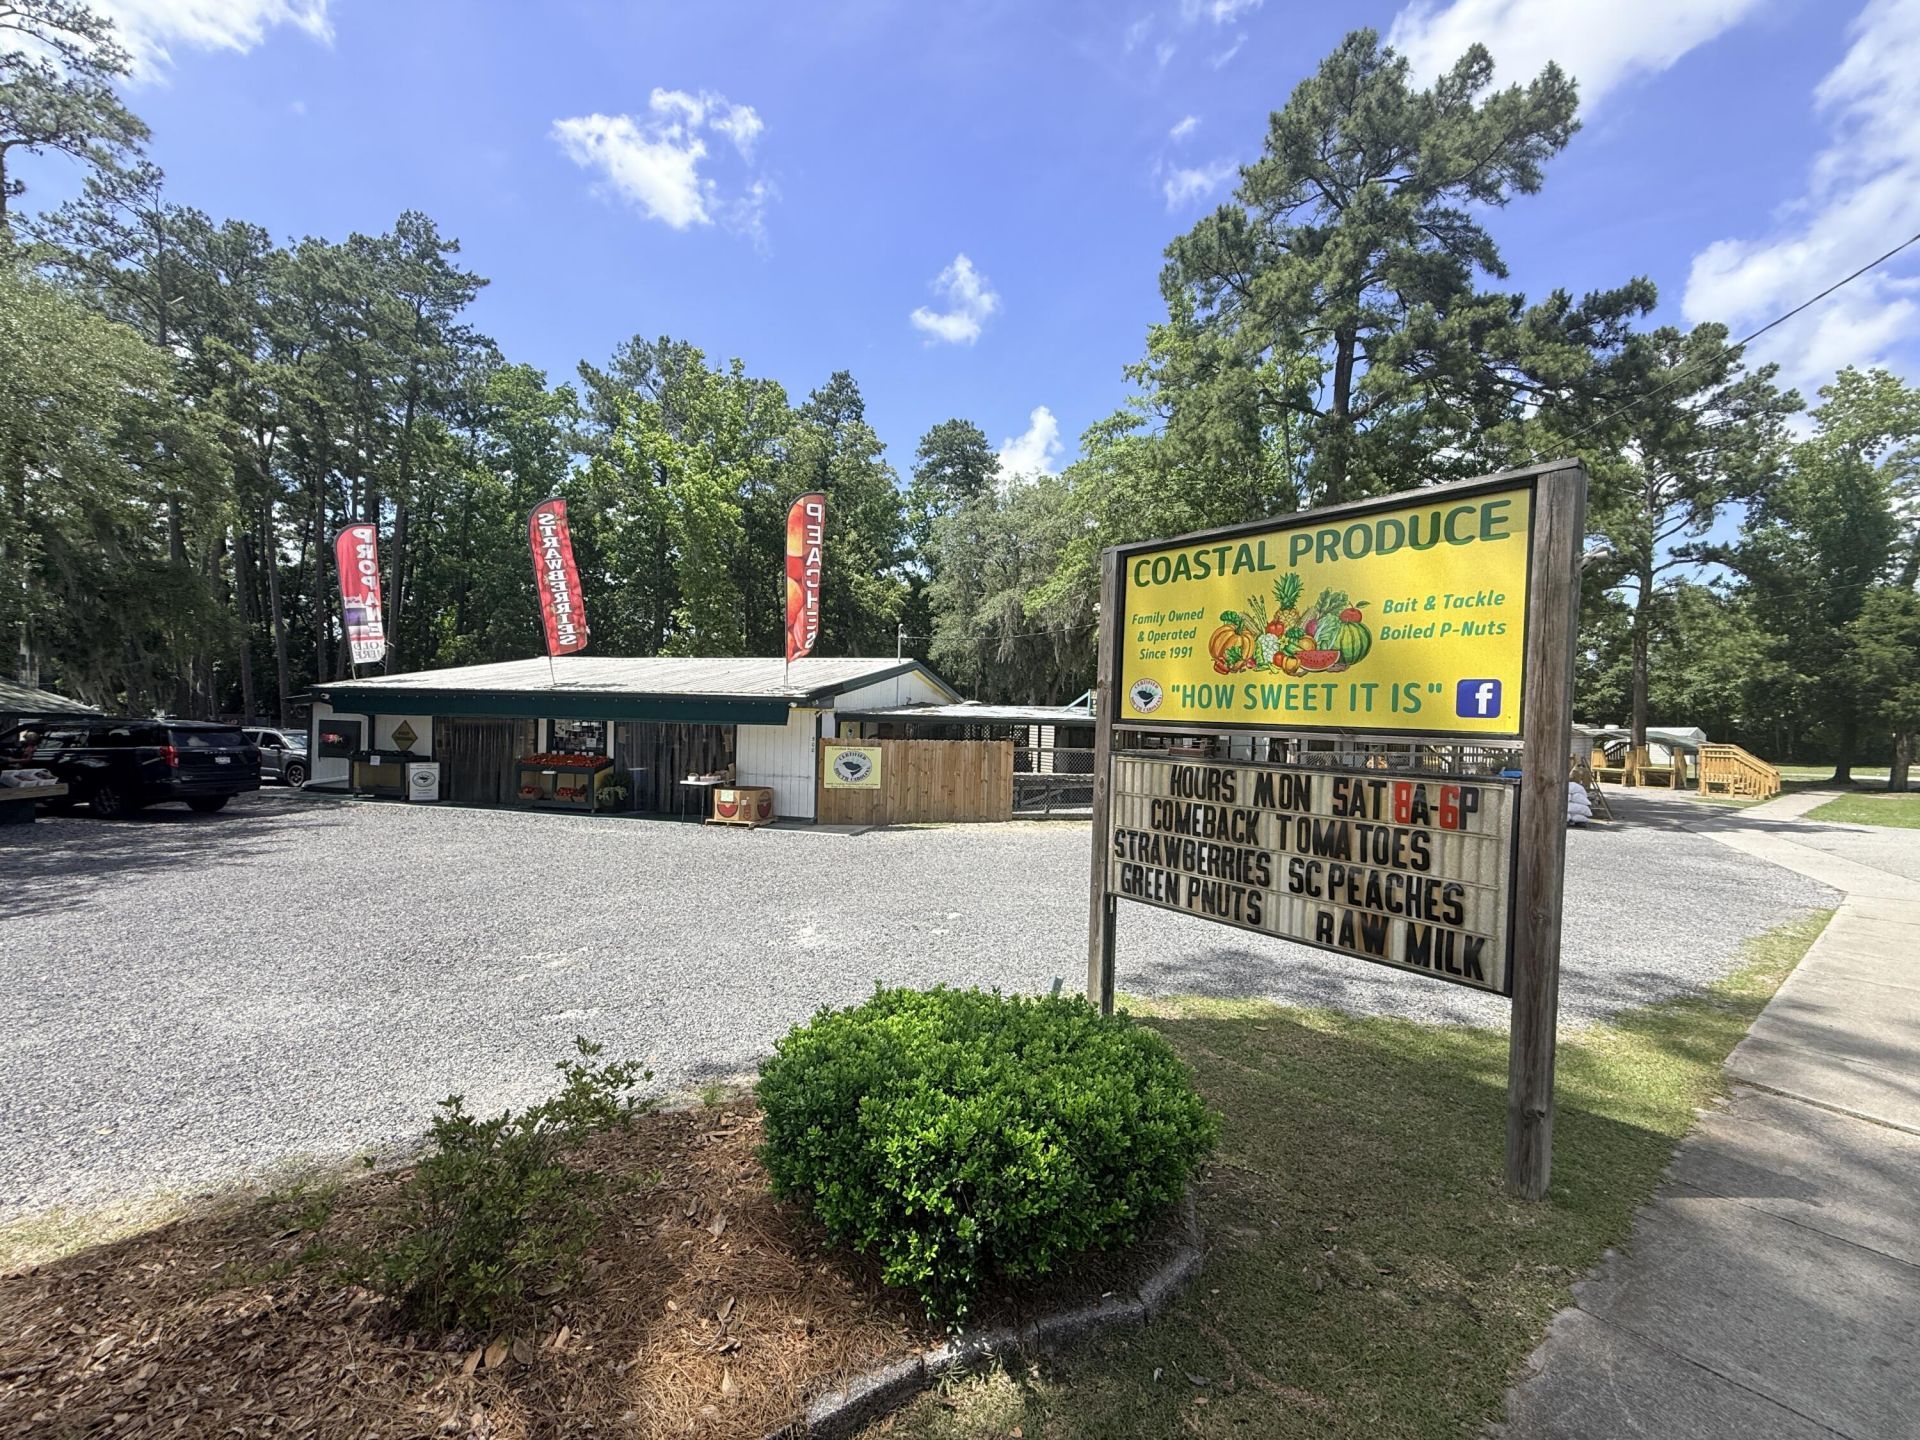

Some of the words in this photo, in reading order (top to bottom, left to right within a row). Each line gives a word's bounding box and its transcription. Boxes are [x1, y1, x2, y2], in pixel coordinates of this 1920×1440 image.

[1133, 540, 1276, 588] COASTAL
[1289, 499, 1512, 568] PRODUCE
[1132, 611, 1166, 627] Family
[1168, 606, 1205, 622] Owned
[1383, 598, 1418, 614] Bait
[1423, 595, 1436, 611] &
[1443, 590, 1505, 609] Tackle
[1137, 631, 1145, 642] &
[1147, 626, 1197, 645] Operated
[1380, 622, 1435, 640] Boiled
[1440, 620, 1507, 637] P-Nuts
[1139, 648, 1166, 660] Since
[1169, 646, 1193, 658] 1991
[1171, 683, 1235, 709] "HOW
[1244, 683, 1338, 712] SWEET
[1350, 683, 1379, 712] IT
[1171, 764, 1235, 804] HOURS
[1253, 771, 1311, 813] MON
[1333, 777, 1386, 820] SAT
[1394, 782, 1479, 830] 8A-6P
[1151, 799, 1260, 846] COMEBACK
[1276, 814, 1431, 872] TOMATOES
[1114, 829, 1271, 888] STRAWBERRIES
[1288, 857, 1321, 898] SC
[1329, 865, 1464, 925] PEACHES
[1121, 862, 1180, 906] GREEN
[1187, 877, 1262, 925] PNUTS
[1316, 910, 1391, 956] RAW
[1405, 922, 1484, 981] MILK
